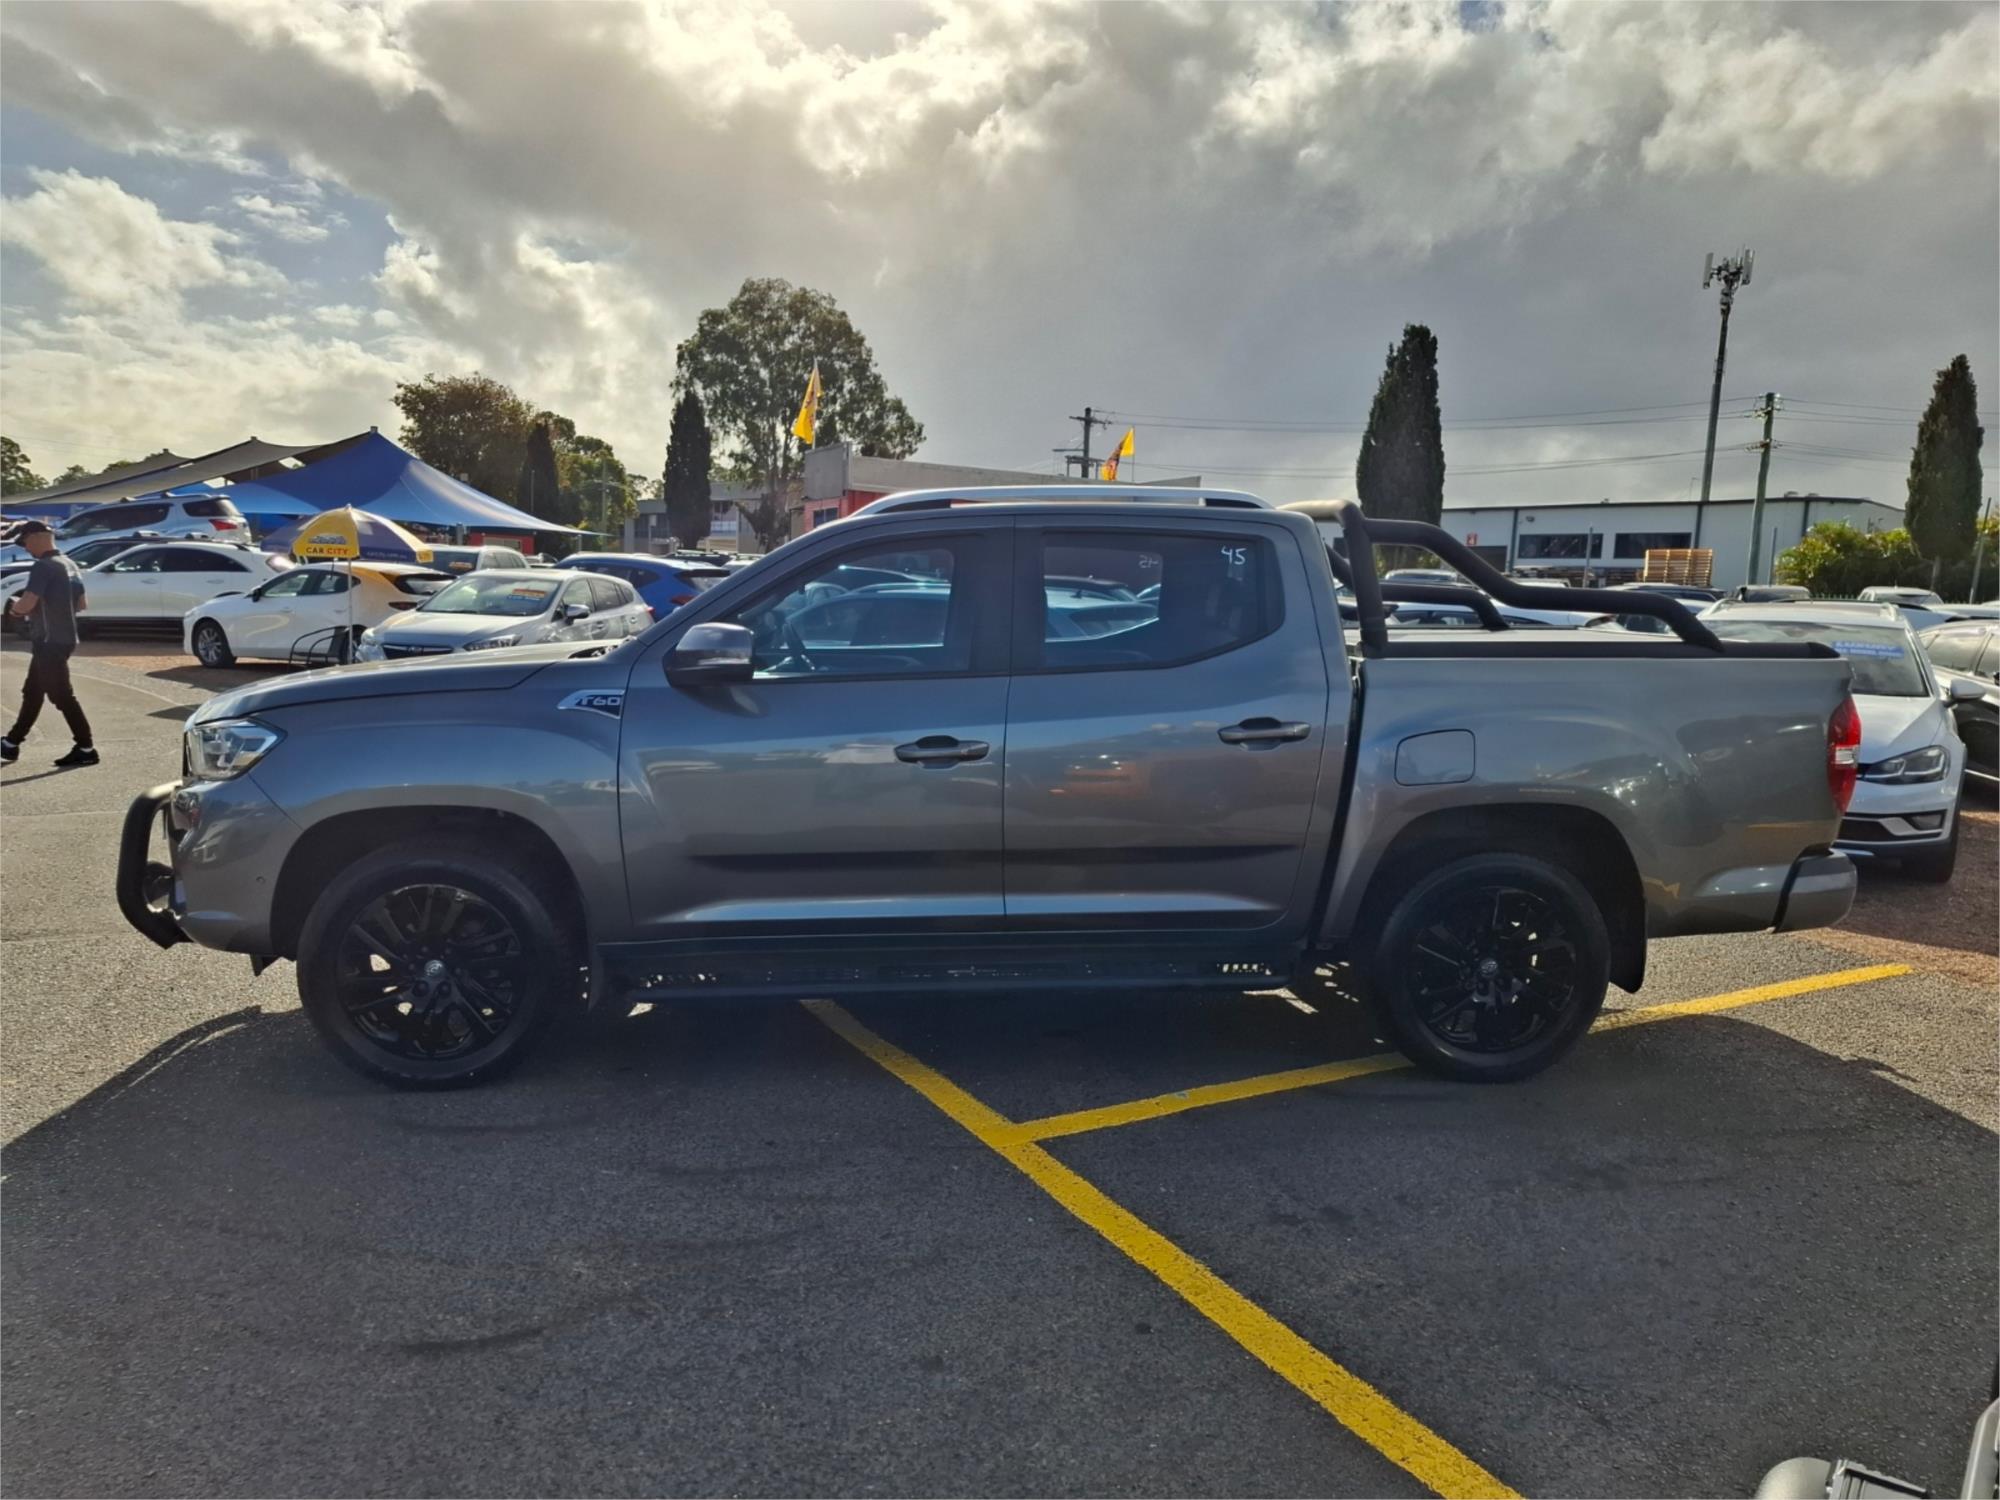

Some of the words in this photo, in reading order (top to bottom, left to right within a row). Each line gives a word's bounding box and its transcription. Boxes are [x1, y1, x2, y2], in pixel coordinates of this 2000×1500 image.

[305, 546, 324, 554] CAR
[327, 547, 349, 555] CITY
[1221, 546, 1247, 565] 45
[580, 696, 621, 706] T60
